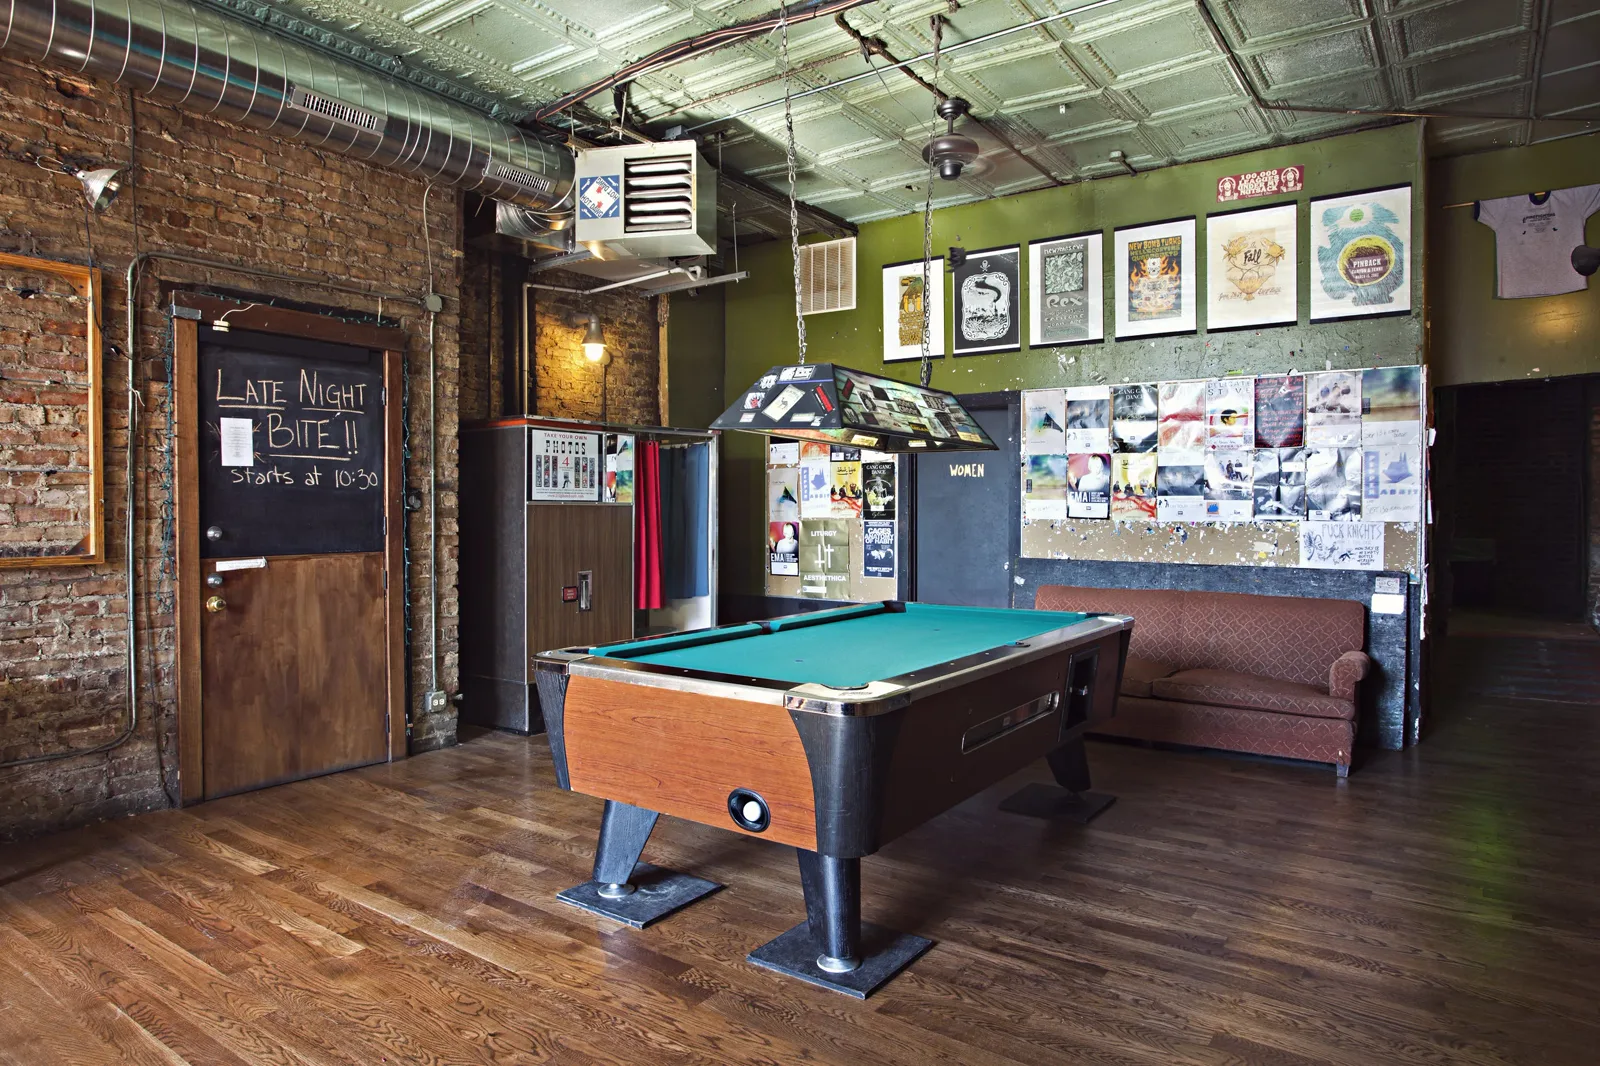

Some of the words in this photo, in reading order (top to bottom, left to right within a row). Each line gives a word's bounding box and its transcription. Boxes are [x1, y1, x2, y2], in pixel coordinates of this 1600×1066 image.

[580, 194, 592, 206] HOT
[590, 203, 604, 218] DAWG
[1129, 241, 1143, 250] NEW
[1143, 239, 1161, 249] BOMB
[1243, 248, 1262, 265] Fall
[1352, 258, 1382, 268] PINBACK
[1046, 294, 1083, 309] Rex
[216, 368, 287, 404] LATE
[299, 368, 367, 411] NIGHT
[1207, 387, 1251, 396] STVE
[545, 440, 586, 455] PHOTOS
[562, 456, 570, 467] 4
[304, 464, 323, 486] at
[335, 468, 378, 490] 10:30
[949, 463, 985, 478] WOMEN
[1321, 523, 1345, 539] FUCK
[1347, 523, 1382, 540] KNIGHTS
[770, 552, 785, 562] EMA
